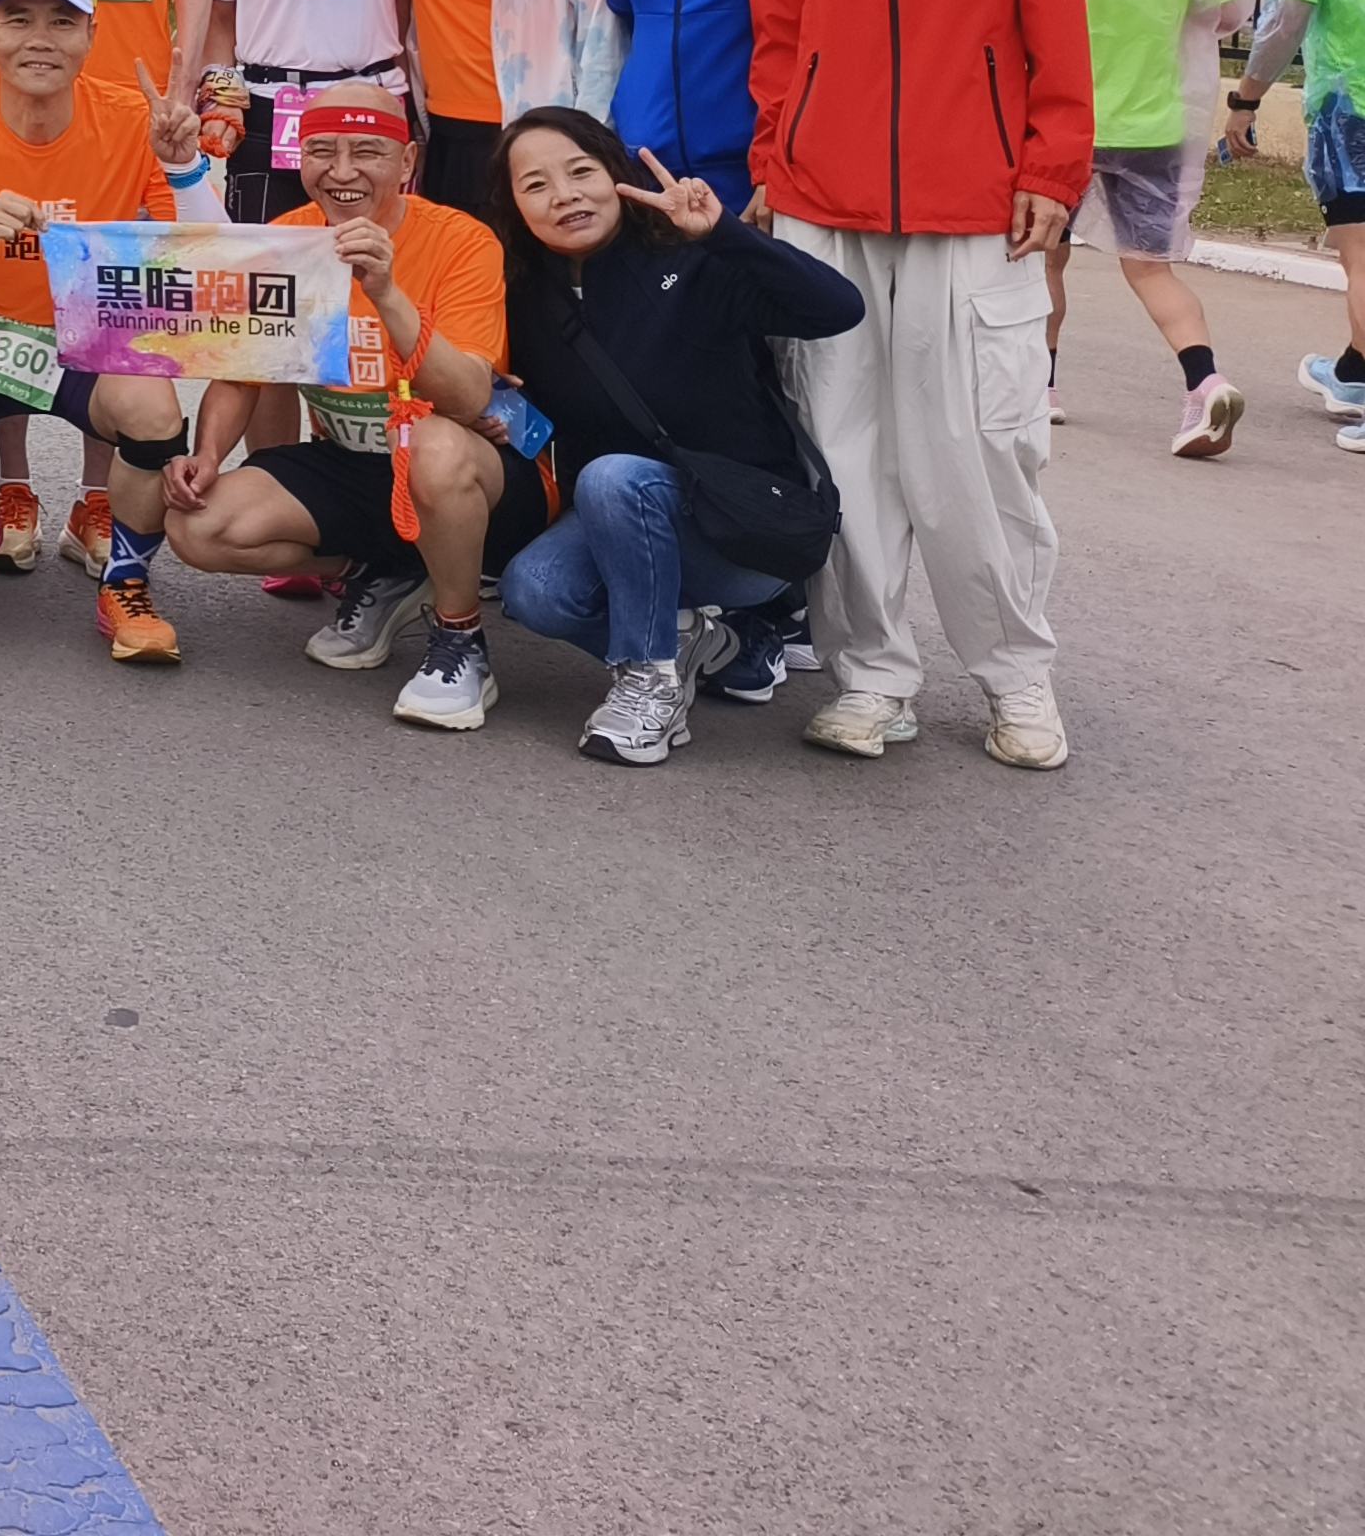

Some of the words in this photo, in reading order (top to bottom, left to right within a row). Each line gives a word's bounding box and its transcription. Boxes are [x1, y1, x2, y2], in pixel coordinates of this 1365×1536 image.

[4, 229, 41, 261] 跑
[96, 265, 296, 319] 黑暗跑团
[660, 272, 679, 291] alo
[97, 310, 179, 337] Running
[185, 314, 203, 333] in
[210, 314, 241, 335] the
[248, 317, 296, 339] Dark
